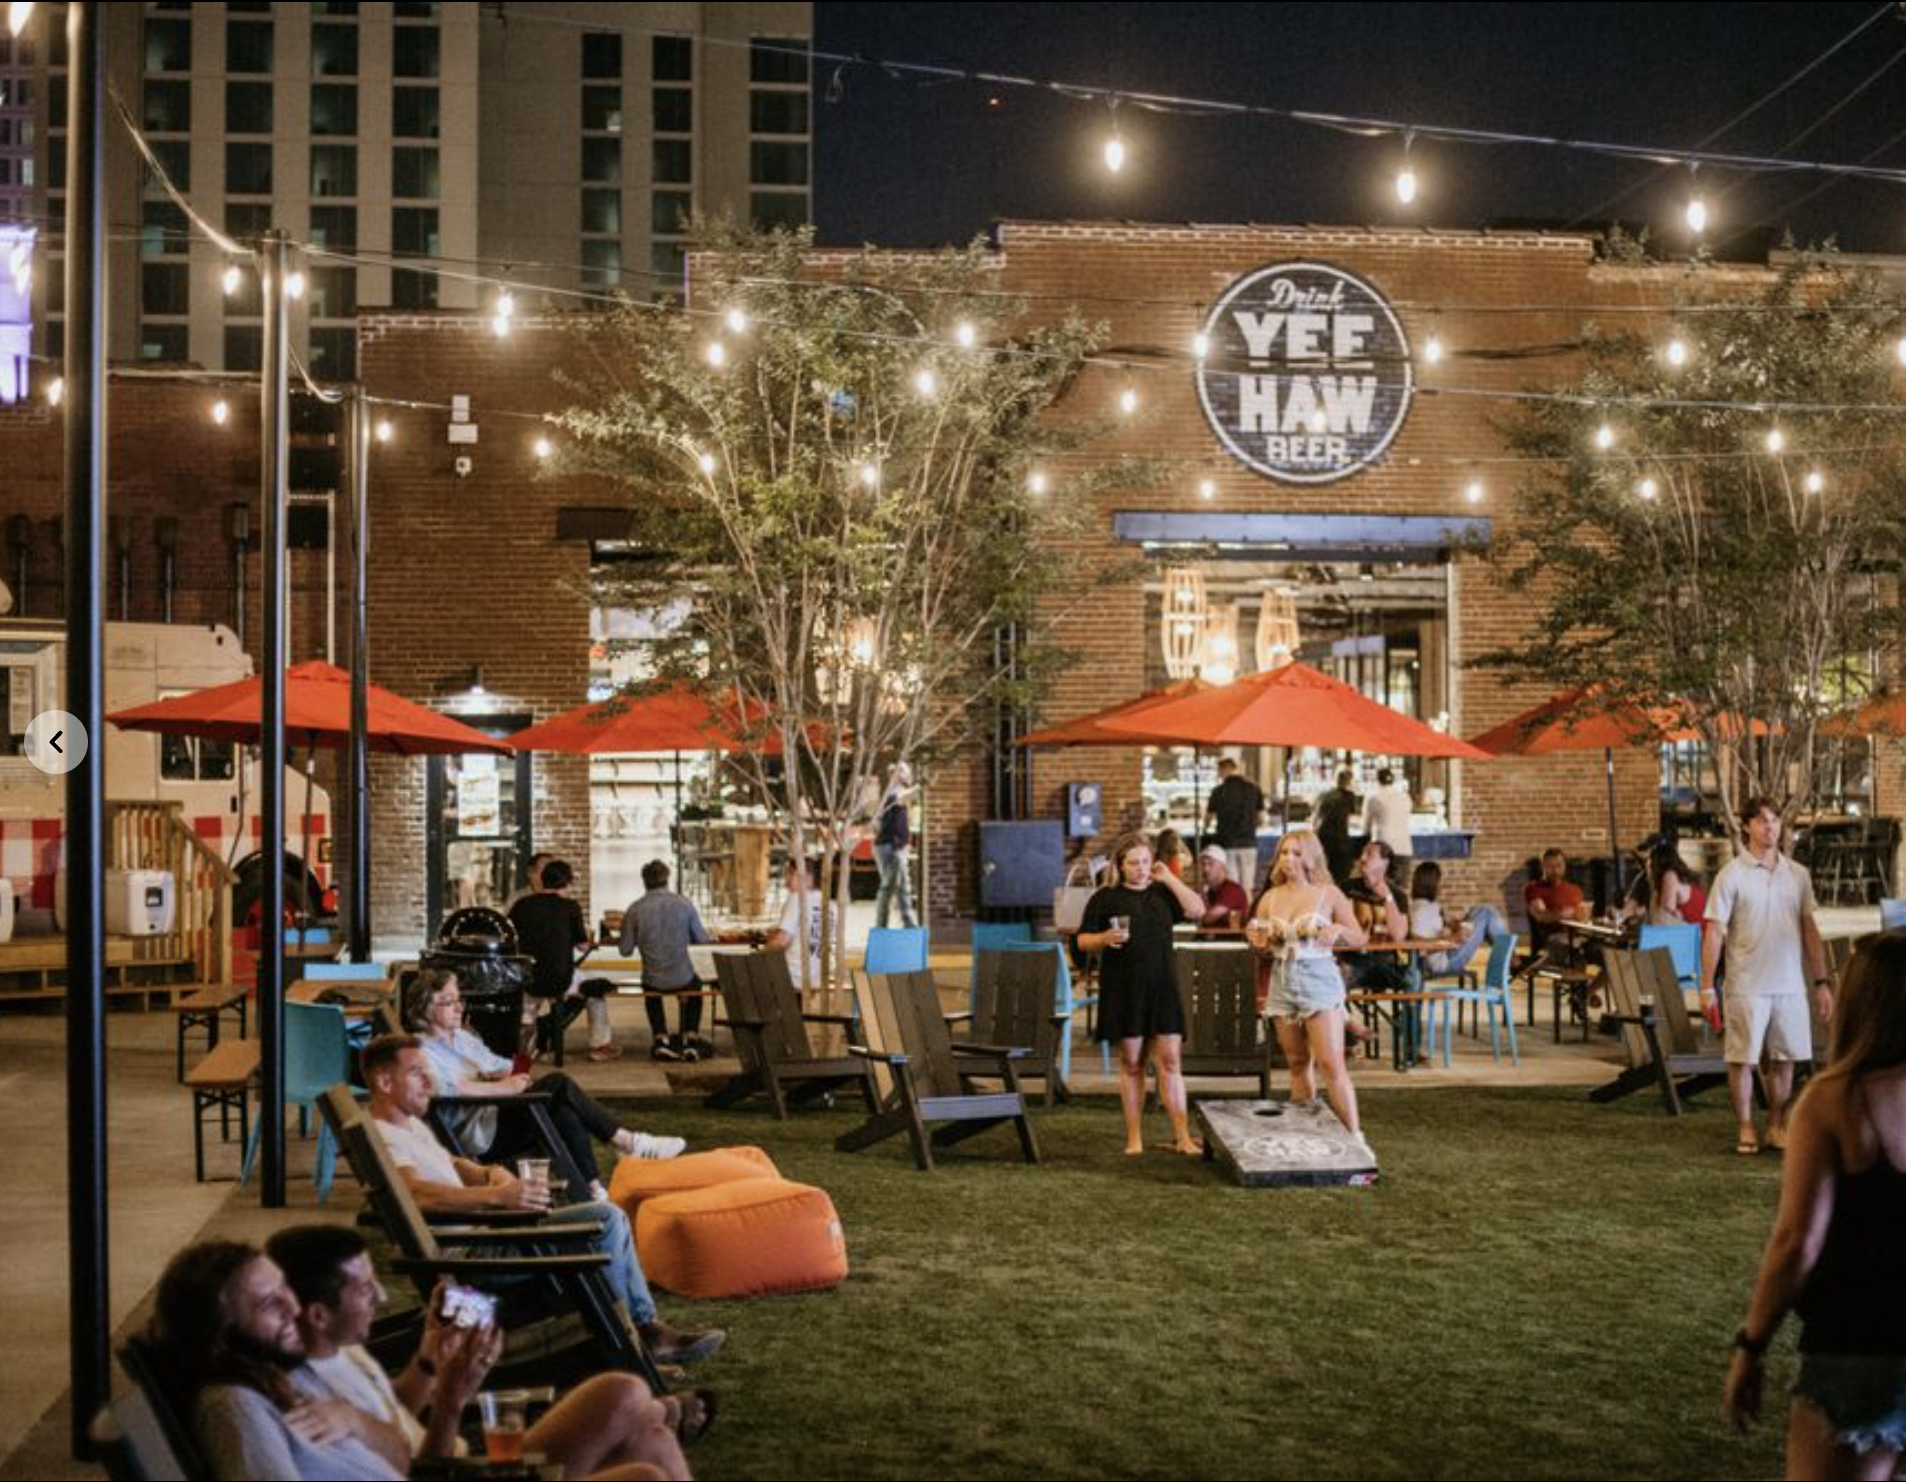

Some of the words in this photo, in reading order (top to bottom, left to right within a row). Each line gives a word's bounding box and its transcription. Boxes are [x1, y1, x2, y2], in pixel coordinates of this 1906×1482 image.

[1267, 278, 1344, 310] Drink
[1233, 311, 1374, 368] YEE
[1239, 374, 1378, 433] HAW
[1267, 436, 1346, 463] BEER
